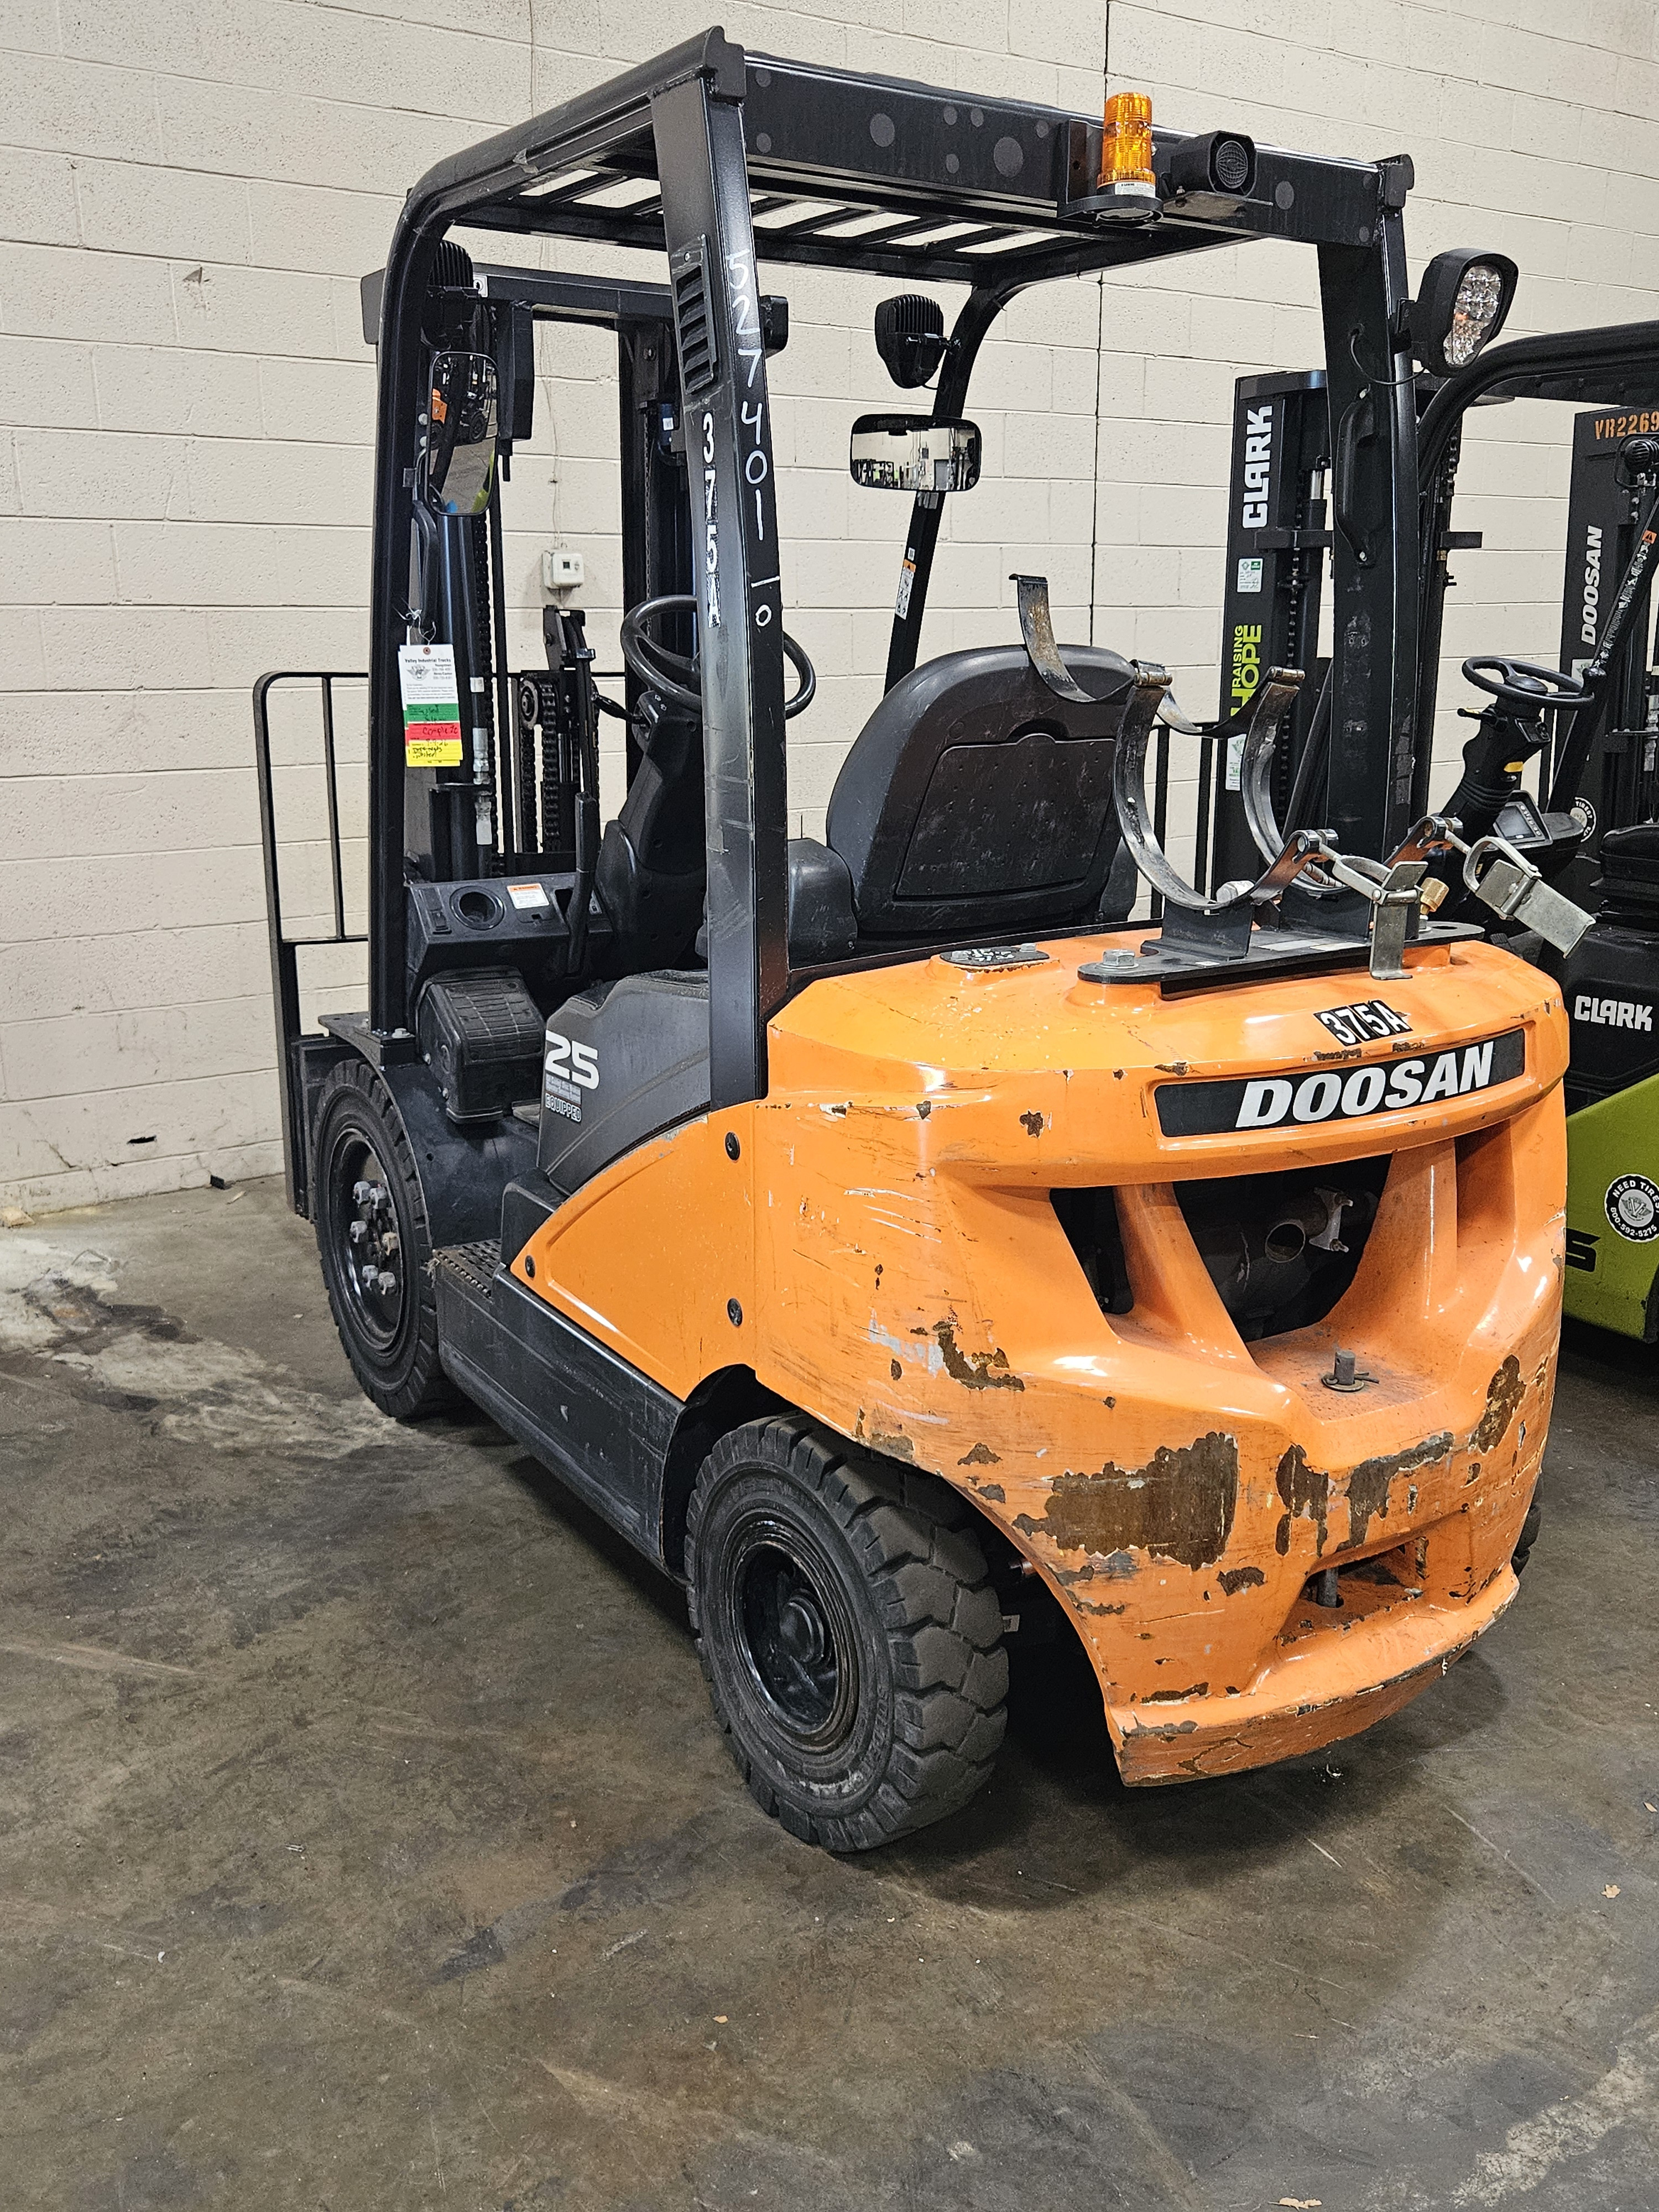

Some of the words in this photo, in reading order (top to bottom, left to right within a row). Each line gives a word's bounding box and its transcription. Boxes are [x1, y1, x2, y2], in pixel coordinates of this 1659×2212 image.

[1242, 405, 1274, 529] CLARK
[1581, 525, 1603, 646] DOOSAN
[1232, 625, 1244, 688] RAISING
[1320, 1002, 1411, 1044] 375A
[1574, 995, 1652, 1031] CLARK
[545, 1029, 599, 1090] 25
[1235, 1041, 1494, 1128] DOOSAN
[545, 1093, 582, 1123] EQUIPPED
[1613, 1180, 1636, 1198] NEED
